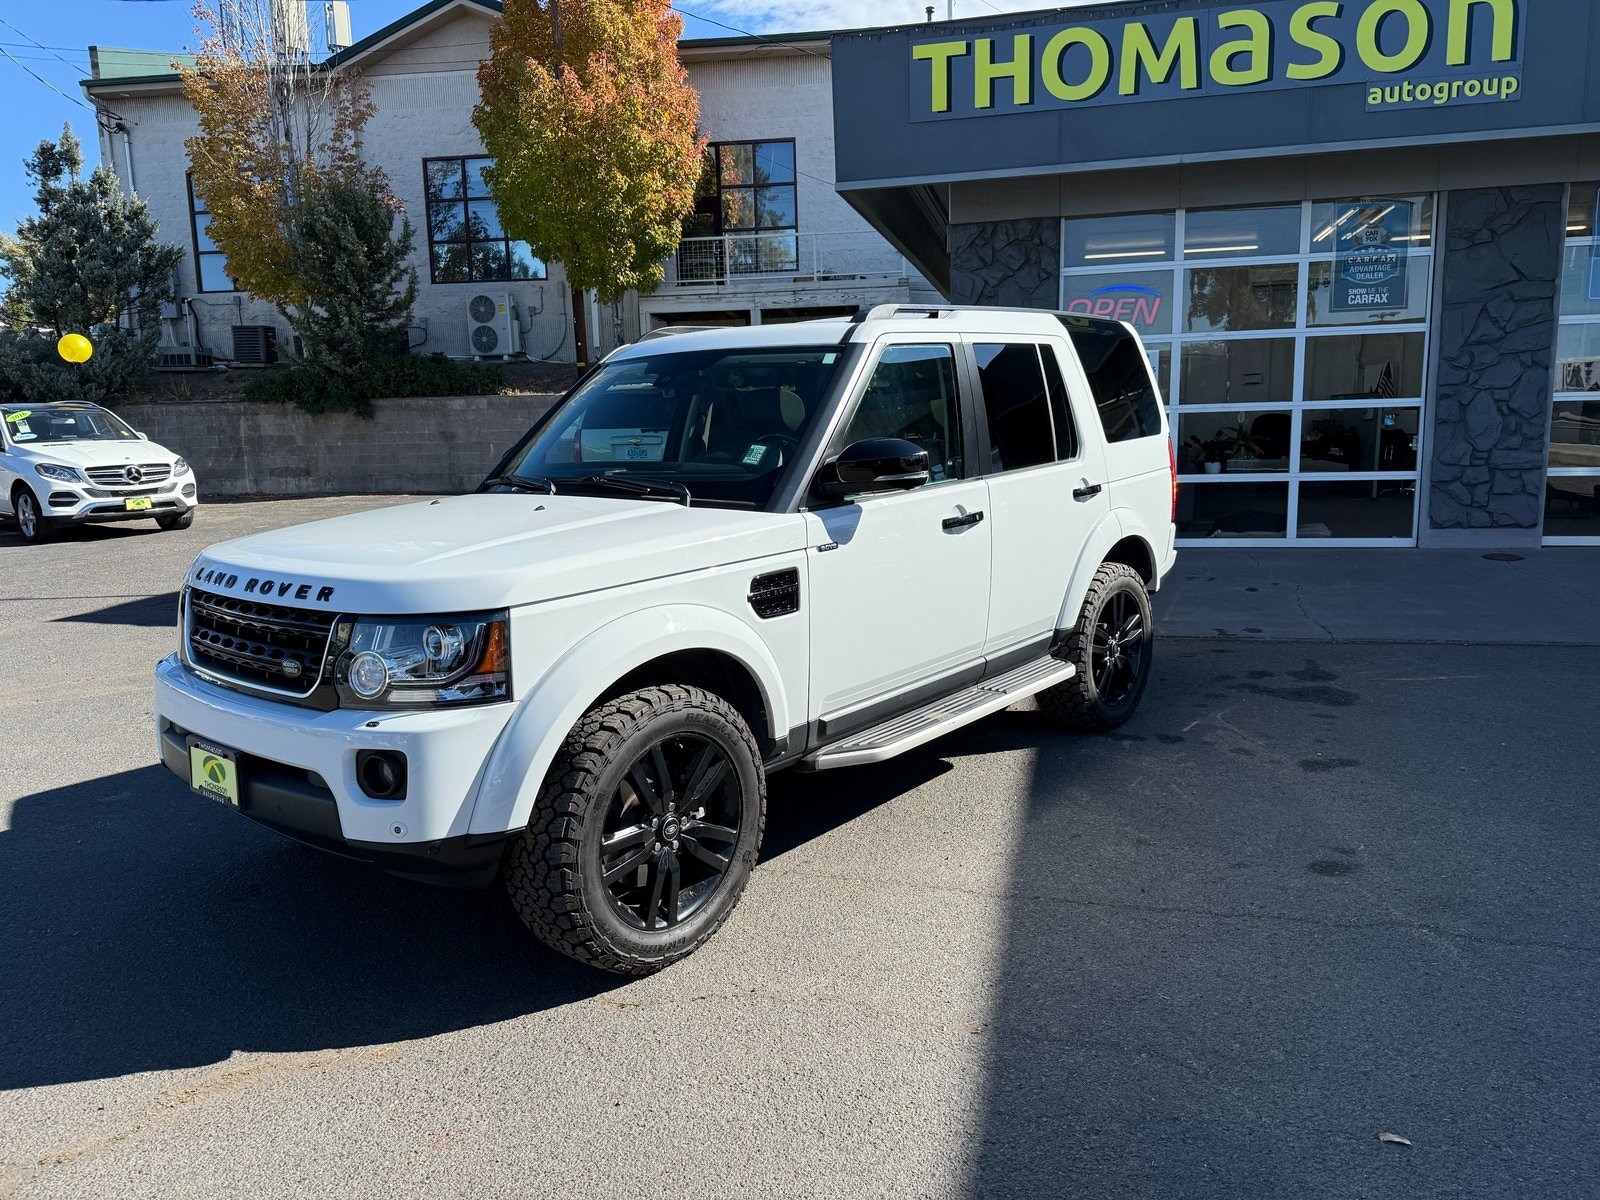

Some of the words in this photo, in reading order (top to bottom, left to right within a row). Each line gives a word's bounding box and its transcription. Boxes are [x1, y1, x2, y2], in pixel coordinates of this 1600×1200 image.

[1367, 76, 1519, 104] autogroup
[1349, 264, 1392, 273] ADVANTAGE
[1356, 272, 1384, 280] DEALER
[1348, 293, 1388, 305] CARFAX
[1068, 298, 1161, 325] OPEN
[195, 567, 238, 589] LAND
[244, 577, 335, 602] ROVER
